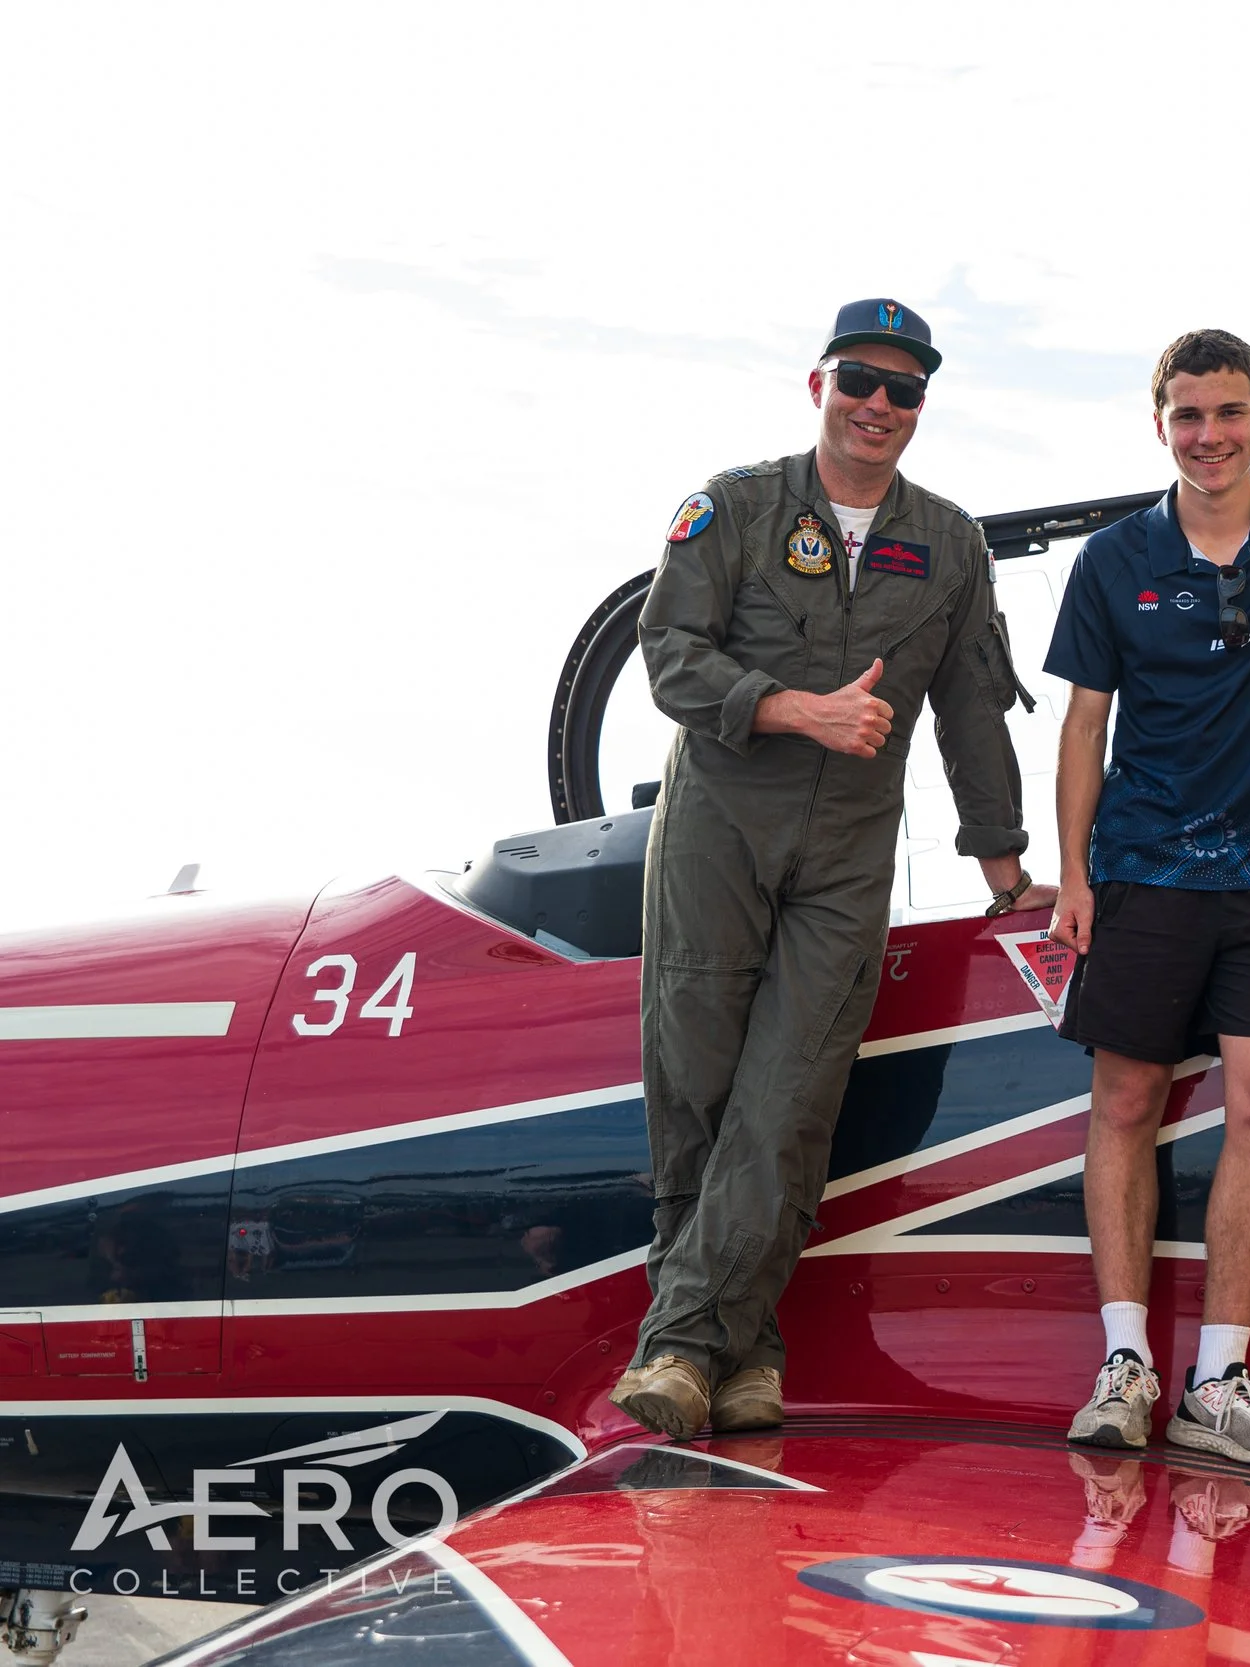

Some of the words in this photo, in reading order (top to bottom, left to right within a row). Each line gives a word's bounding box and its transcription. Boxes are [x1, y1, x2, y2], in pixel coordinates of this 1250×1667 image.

[1138, 603, 1159, 611] NSW
[1040, 953, 1068, 964] CANOPY
[1047, 964, 1063, 975] AND
[1020, 965, 1041, 990] DANGER
[1046, 976, 1063, 986] SEAT
[292, 952, 417, 1037] 34
